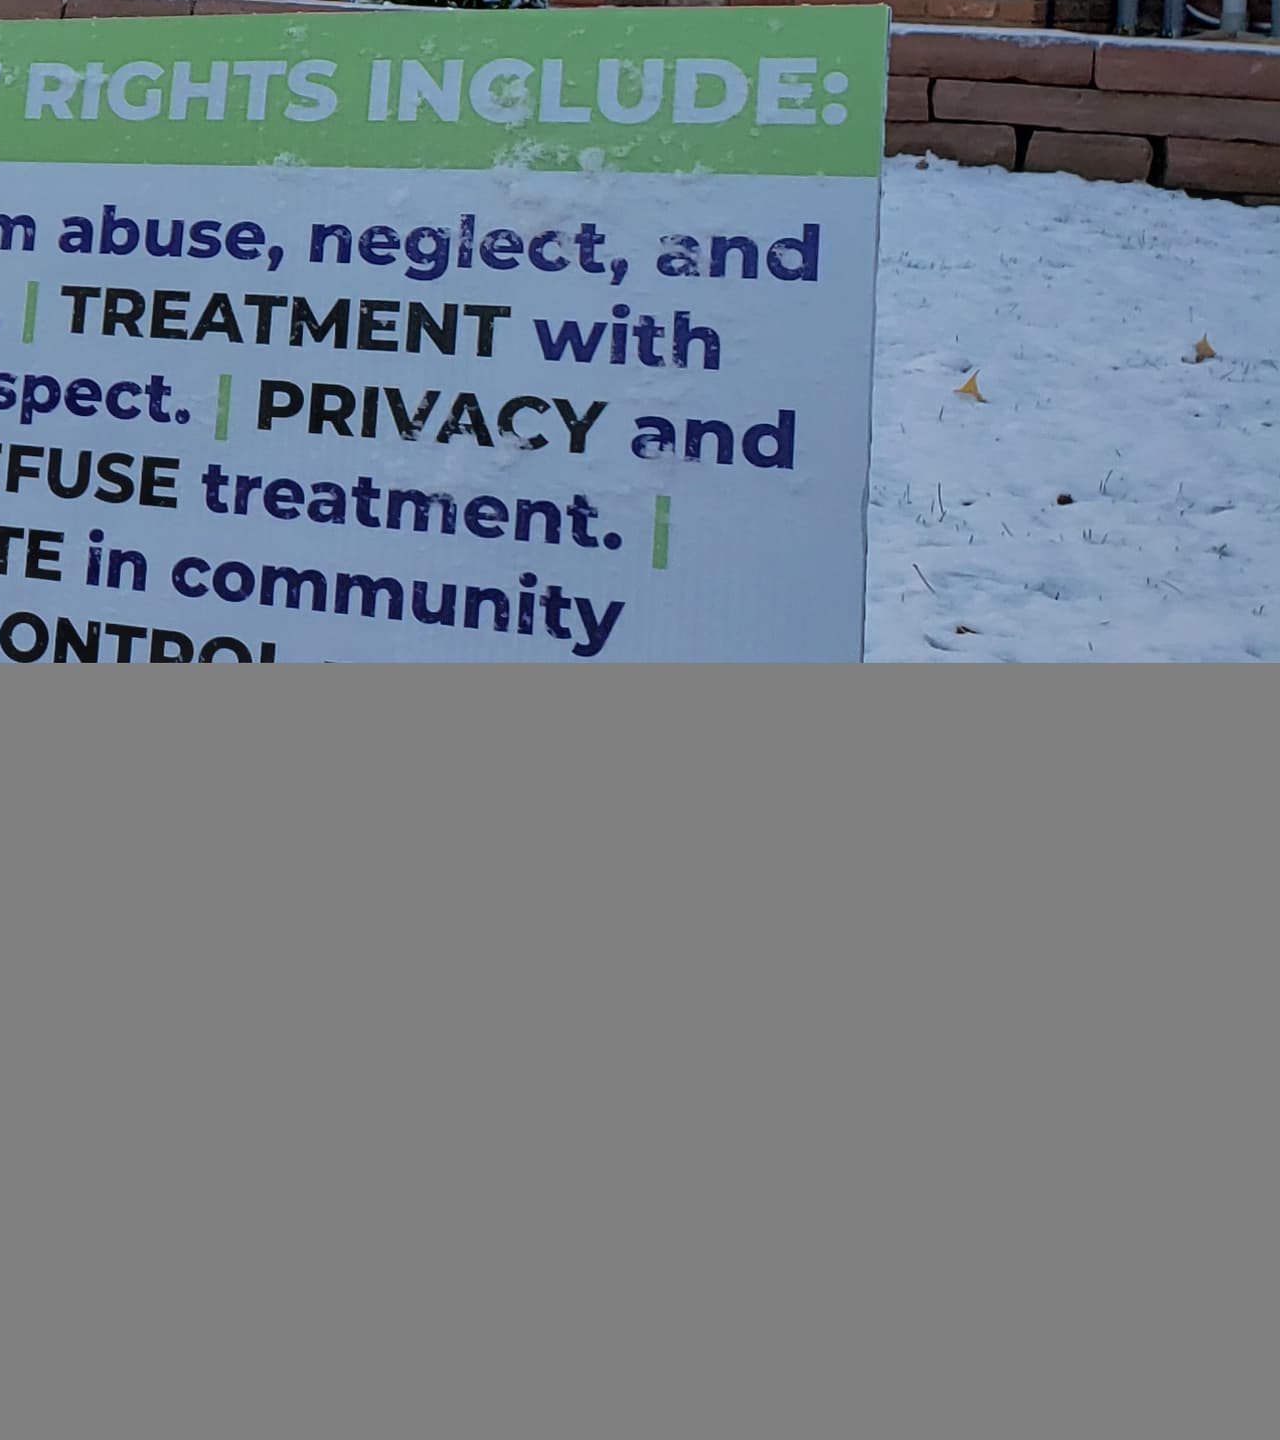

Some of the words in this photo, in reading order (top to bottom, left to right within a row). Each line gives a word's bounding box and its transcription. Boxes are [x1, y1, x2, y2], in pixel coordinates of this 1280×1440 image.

[23, 59, 339, 122] RIGHTS
[366, 56, 850, 127] INCLUDE:
[57, 204, 284, 272] abuse,
[308, 213, 630, 287] neglect,
[655, 222, 821, 282] and
[59, 283, 512, 359] TREATMENT
[532, 302, 722, 371] with
[255, 377, 610, 455] PRIVACY
[630, 408, 797, 471] and
[200, 462, 623, 551] treatment.
[84, 527, 148, 593] in
[170, 555, 627, 659] community
